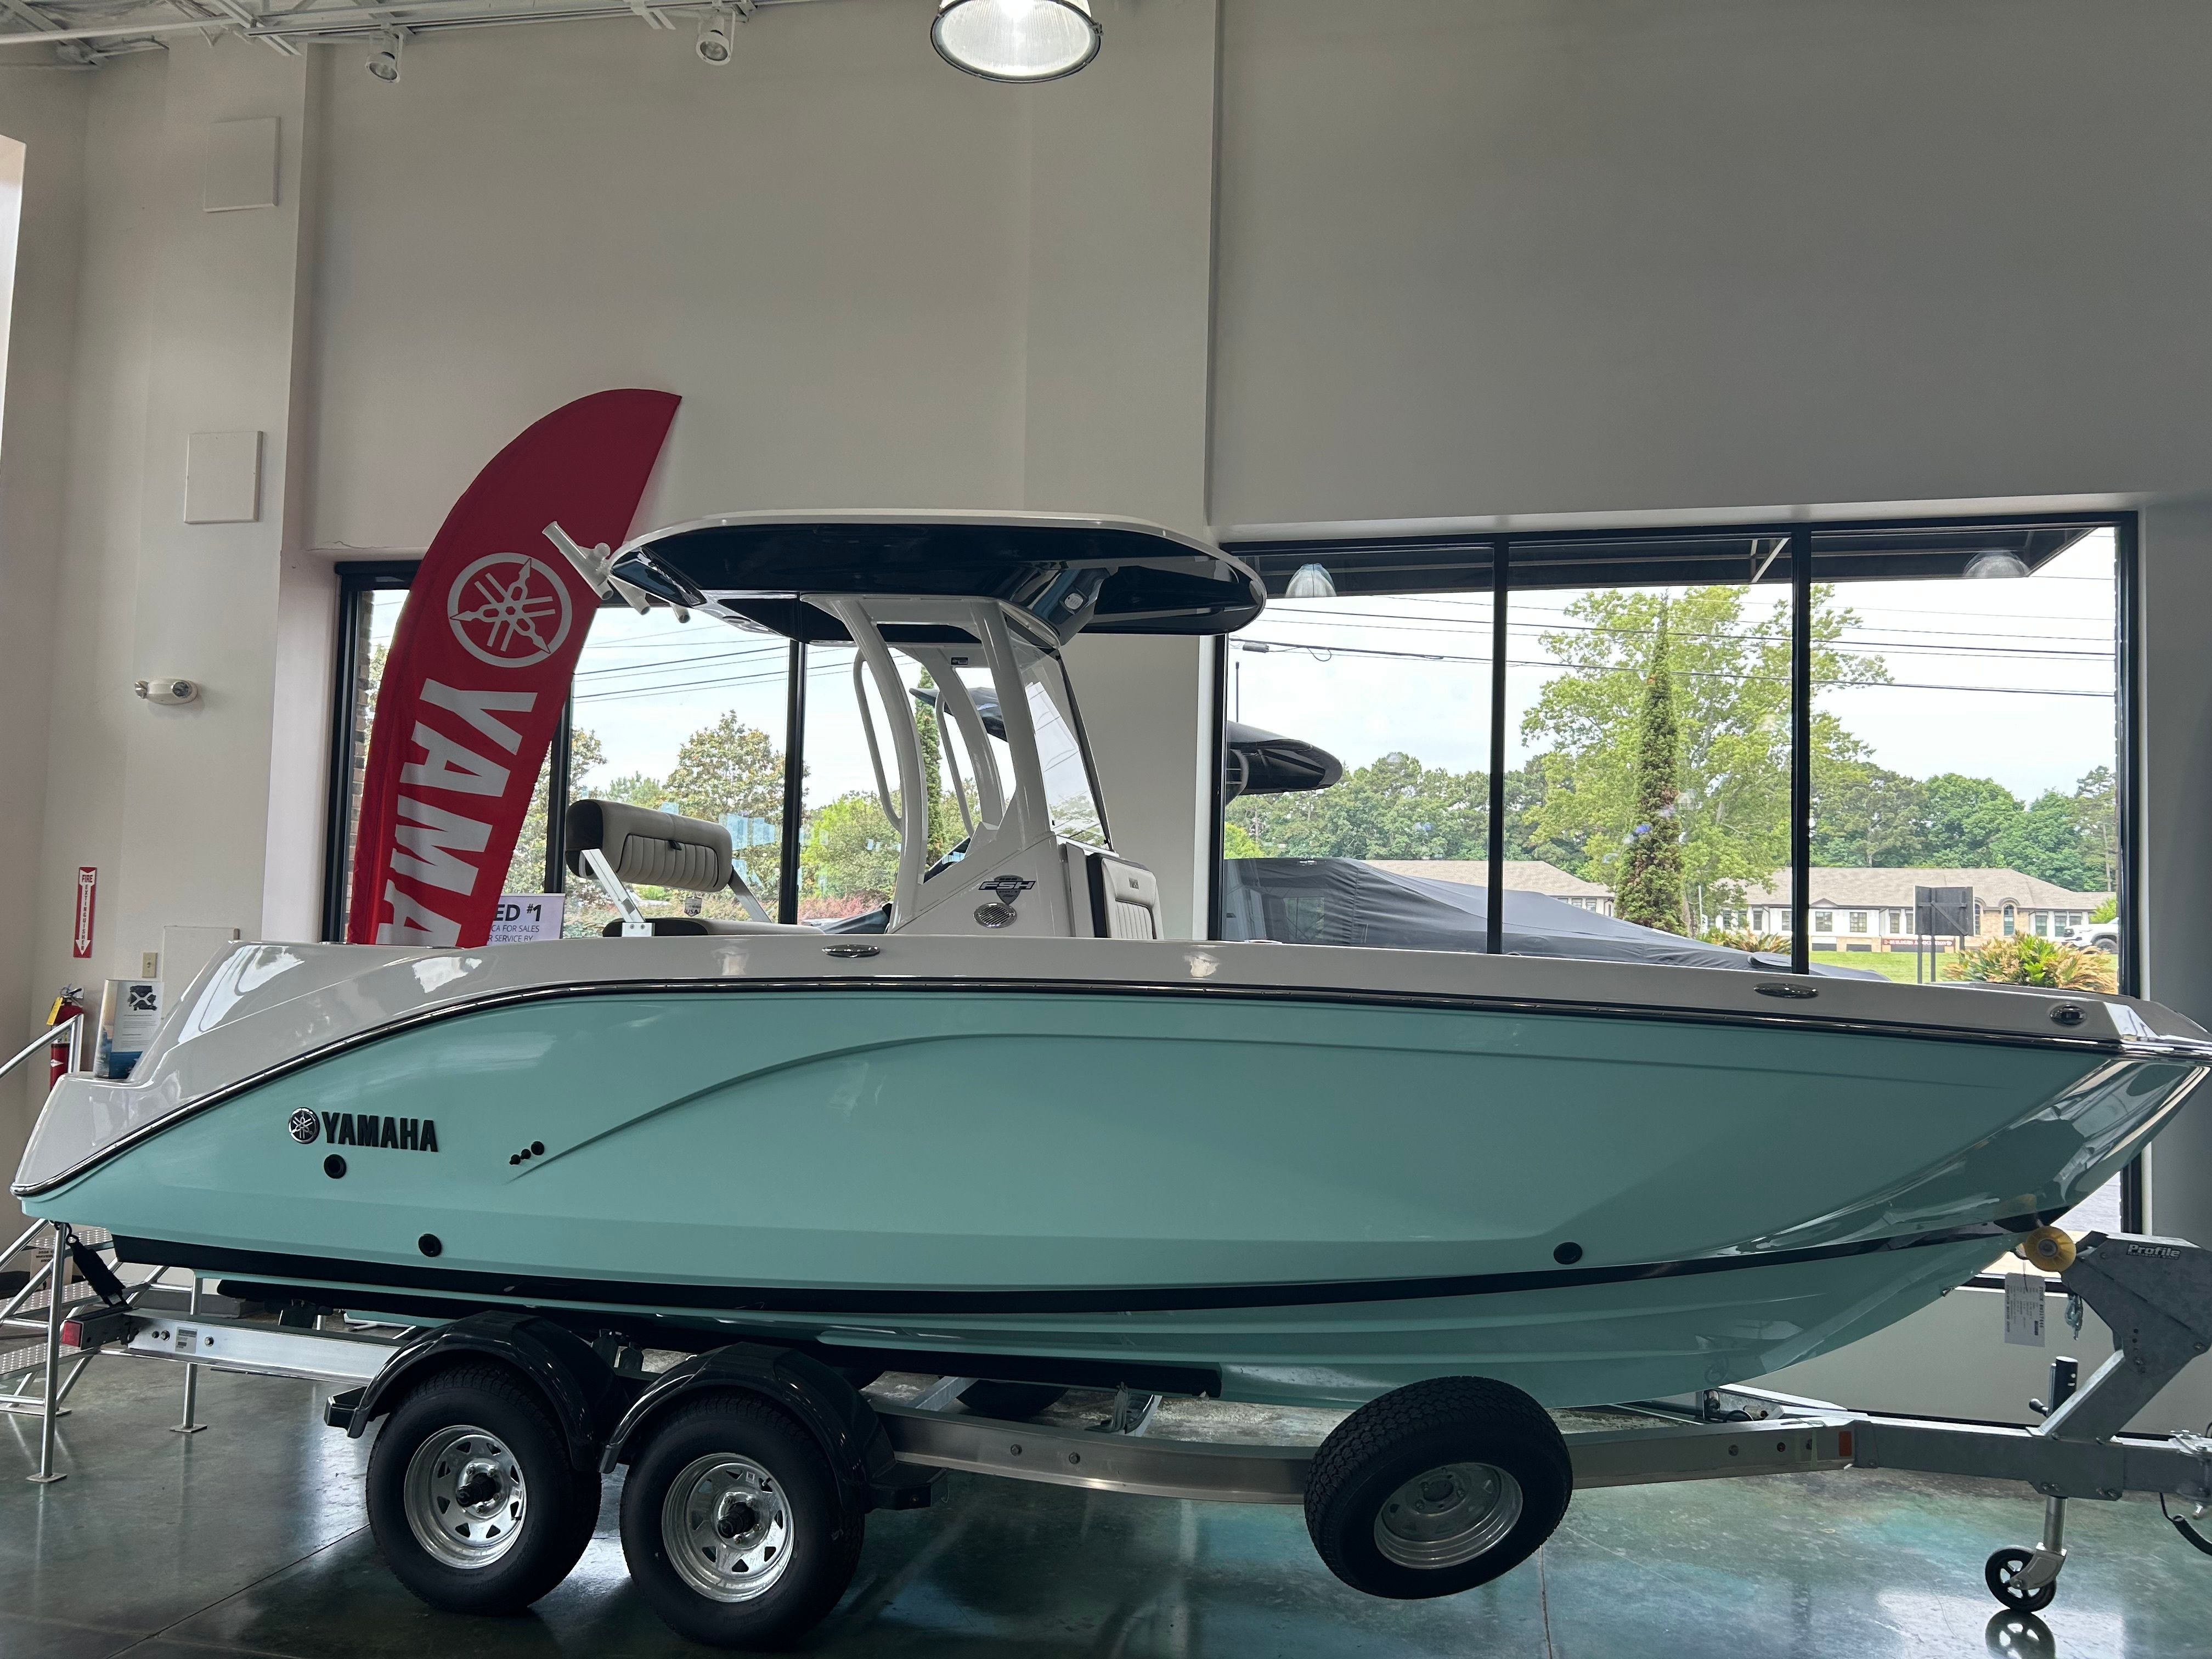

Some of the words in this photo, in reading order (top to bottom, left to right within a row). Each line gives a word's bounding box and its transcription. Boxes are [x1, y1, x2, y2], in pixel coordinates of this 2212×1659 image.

[82, 874, 93, 883] FIRE
[527, 903, 542, 922] #1
[321, 1111, 438, 1152] YAMAHA
[2128, 1244, 2181, 1257] Profile
